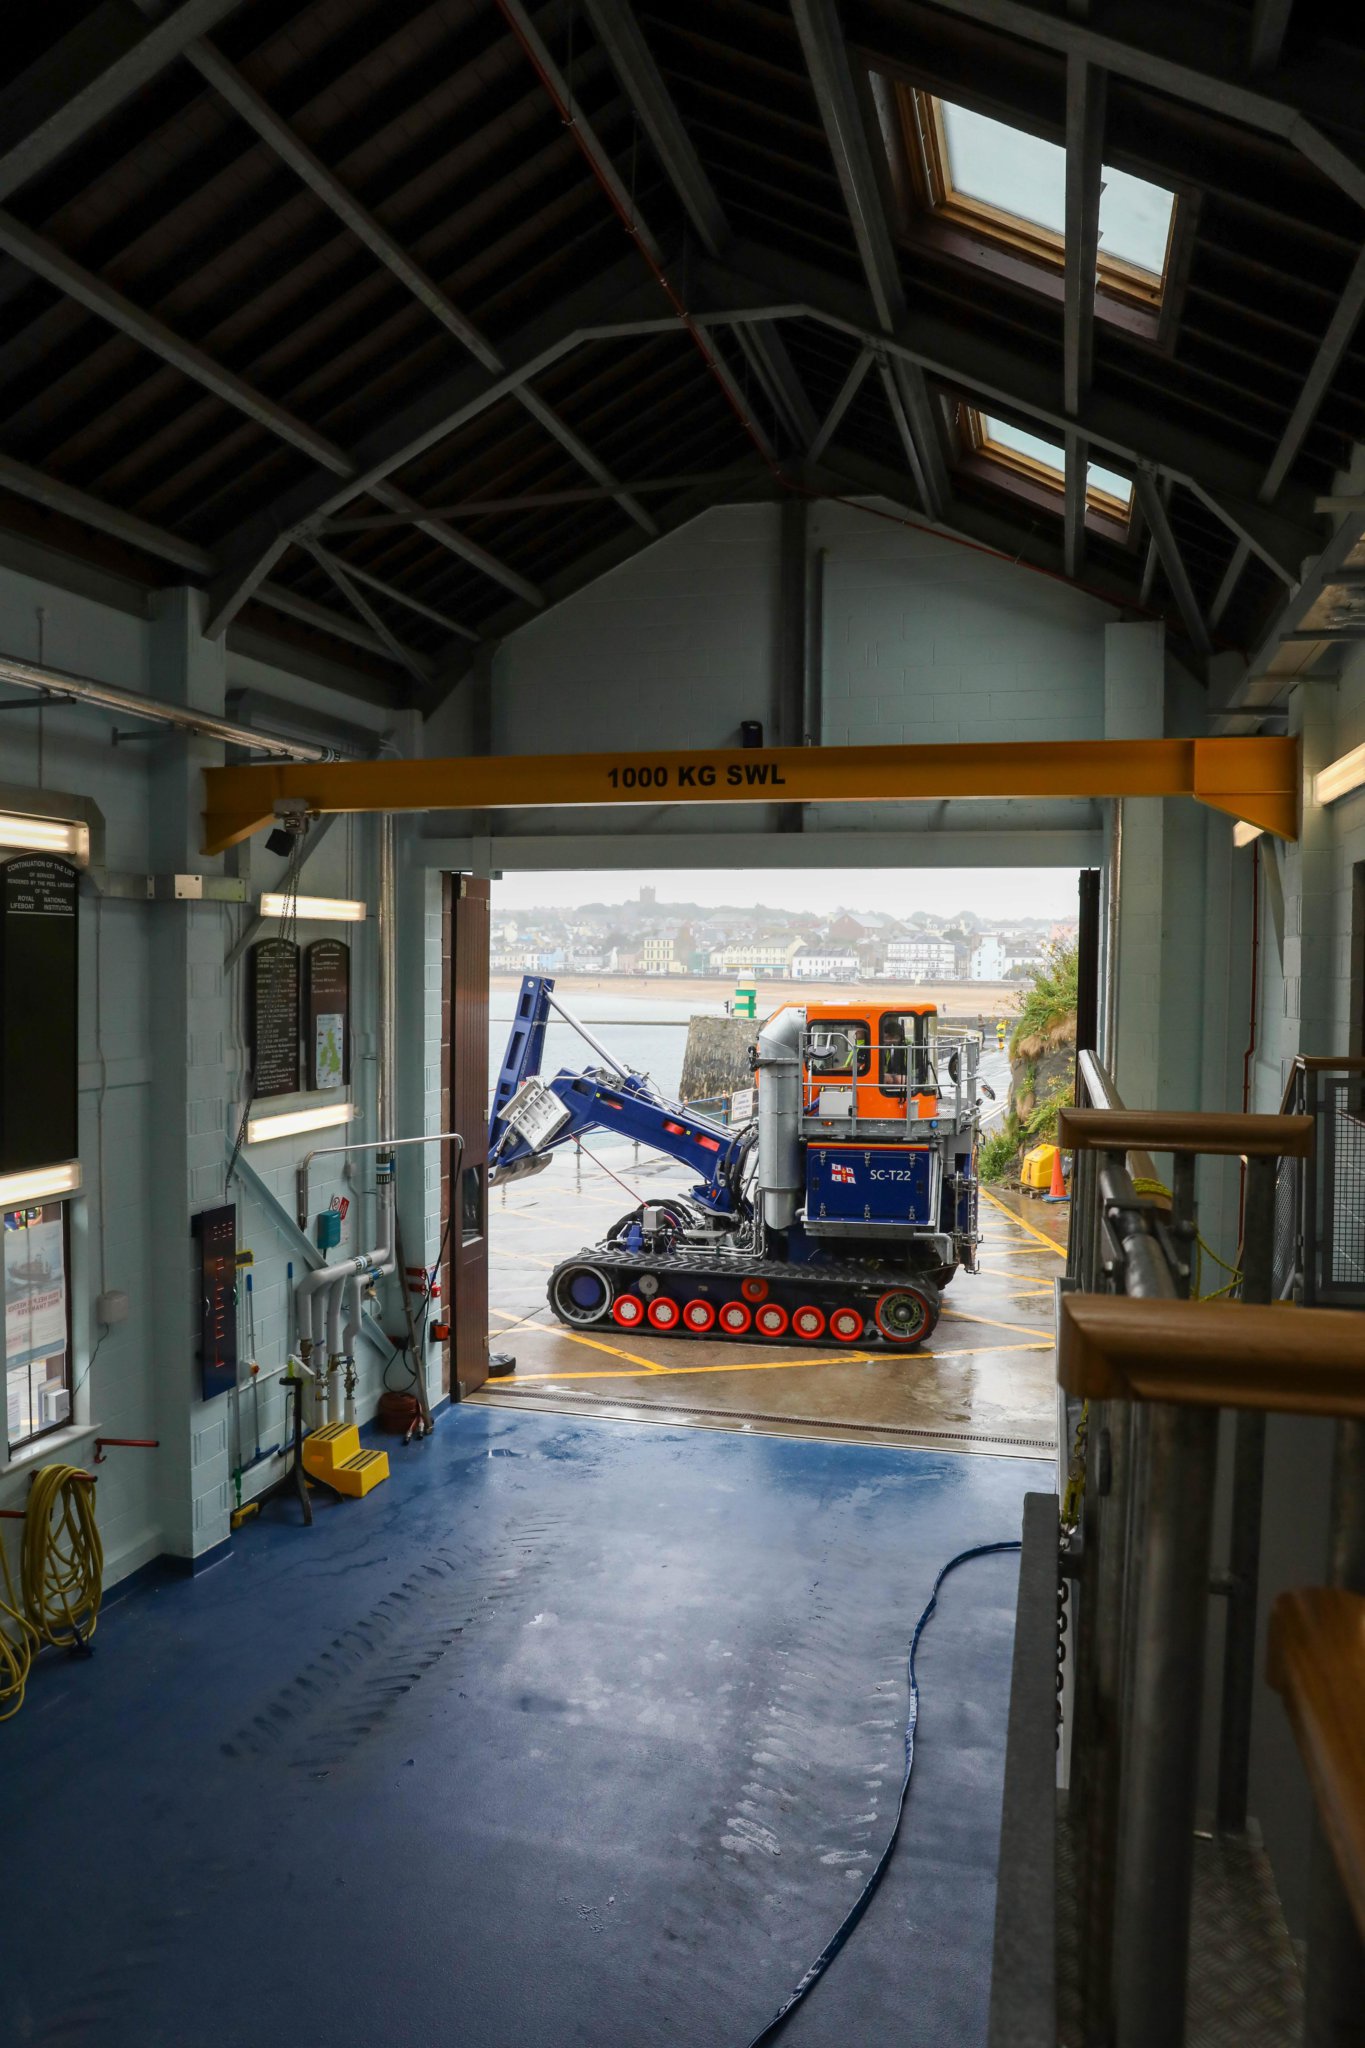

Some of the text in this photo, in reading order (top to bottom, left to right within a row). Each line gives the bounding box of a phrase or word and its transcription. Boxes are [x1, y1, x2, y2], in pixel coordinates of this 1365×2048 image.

[608, 764, 786, 788] 1000 KG SWL
[7, 860, 45, 872] CONTINUATION
[10, 902, 35, 910] LIFEBOAT
[870, 1169, 911, 1181] SC-T22
